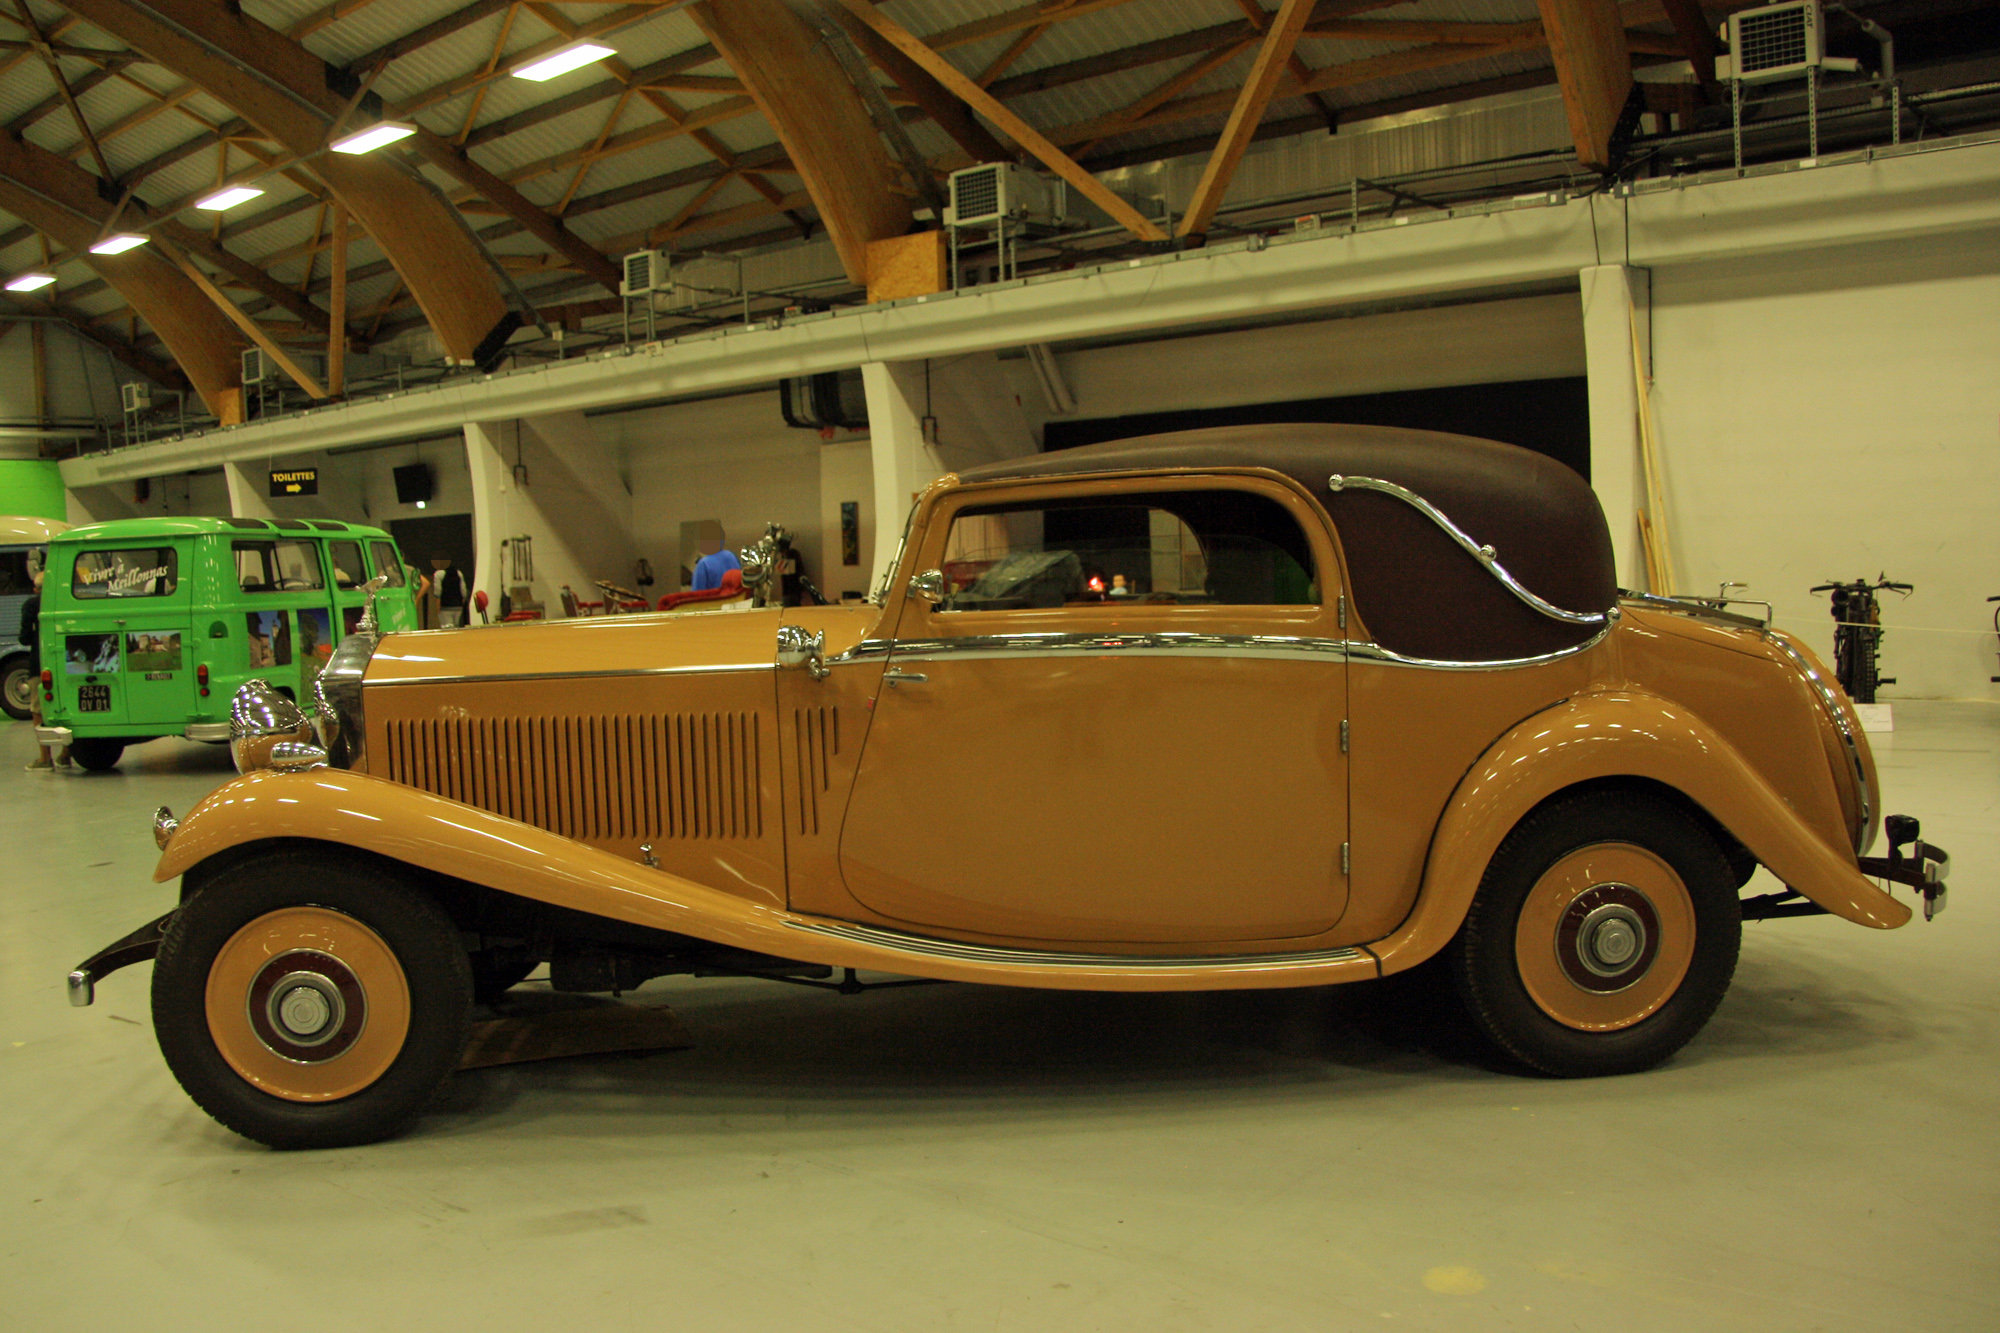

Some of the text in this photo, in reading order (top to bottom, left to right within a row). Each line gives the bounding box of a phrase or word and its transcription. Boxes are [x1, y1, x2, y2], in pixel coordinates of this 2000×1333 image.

[272, 471, 315, 482] TOILETTES
[107, 566, 168, 592] Meillonnas
[82, 686, 106, 698] 2644
